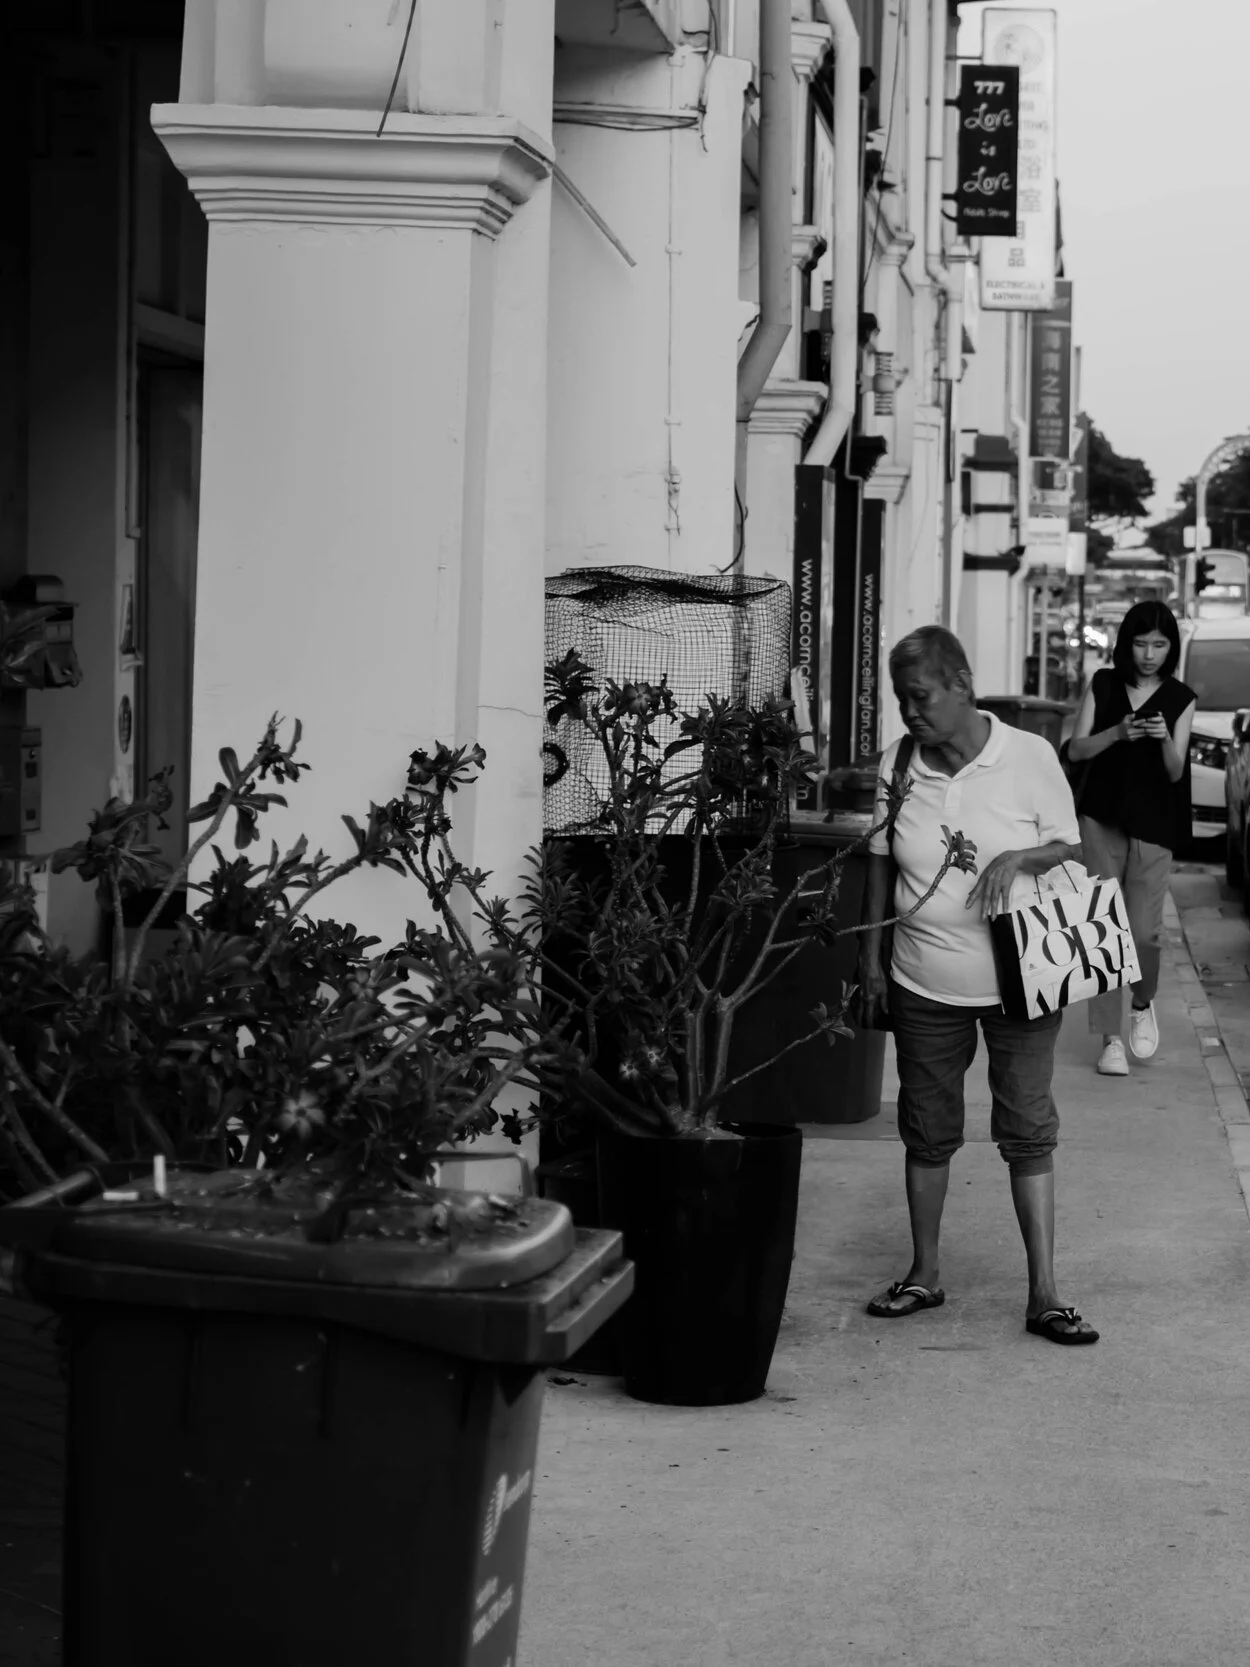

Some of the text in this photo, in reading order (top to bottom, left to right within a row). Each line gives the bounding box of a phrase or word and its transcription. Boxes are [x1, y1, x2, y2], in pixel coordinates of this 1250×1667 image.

[974, 81, 1005, 94] 777
[964, 103, 1013, 132] Love
[980, 141, 997, 157] is
[963, 166, 1013, 195] Love
